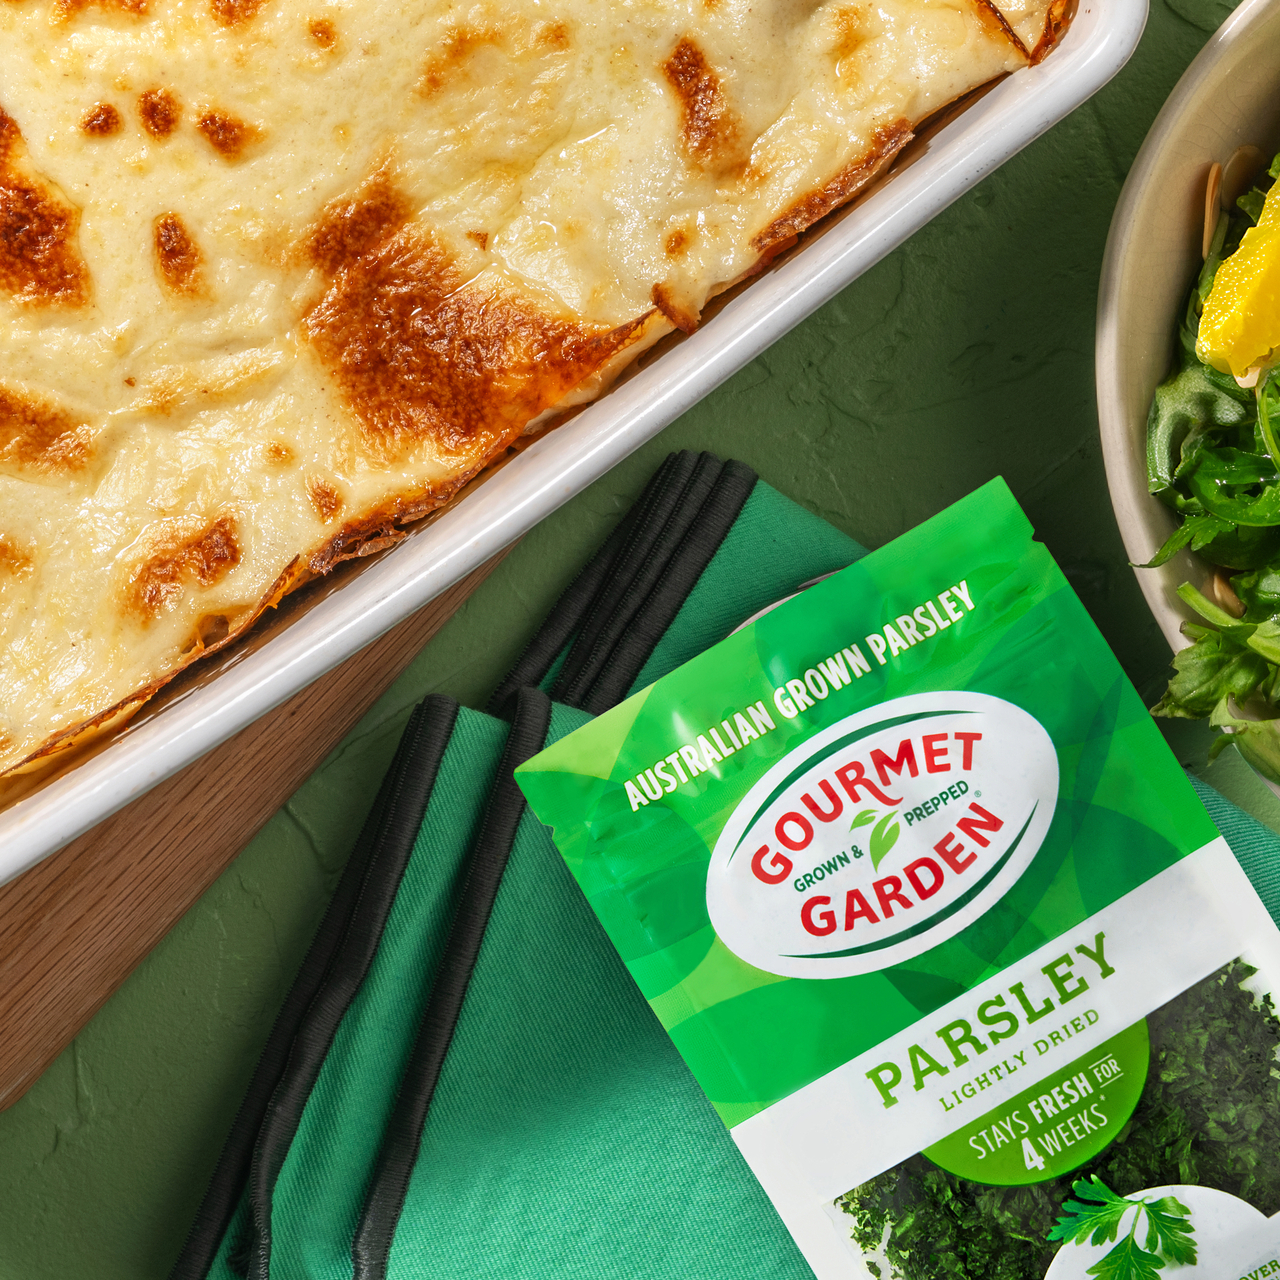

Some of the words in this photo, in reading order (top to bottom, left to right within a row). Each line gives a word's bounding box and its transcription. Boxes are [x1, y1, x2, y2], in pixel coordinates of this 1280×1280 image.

[623, 701, 776, 812] AUSTRALIAN
[773, 643, 872, 719] GROWN
[865, 579, 976, 666] PARSLEY
[750, 731, 983, 885] GOURMET
[793, 851, 851, 892] GROWN
[850, 844, 864, 859] &
[903, 780, 969, 826] PREPPED
[800, 801, 1004, 937] GARDEN
[864, 931, 1116, 1109] PARSLEY
[939, 1050, 1027, 1112] LIGHTLY
[1033, 1009, 1099, 1056] DRIED
[969, 1111, 1029, 1160] STAYS
[1027, 1072, 1094, 1124] FRESH
[1092, 1058, 1121, 1083] FOR
[1021, 1137, 1045, 1171] 4
